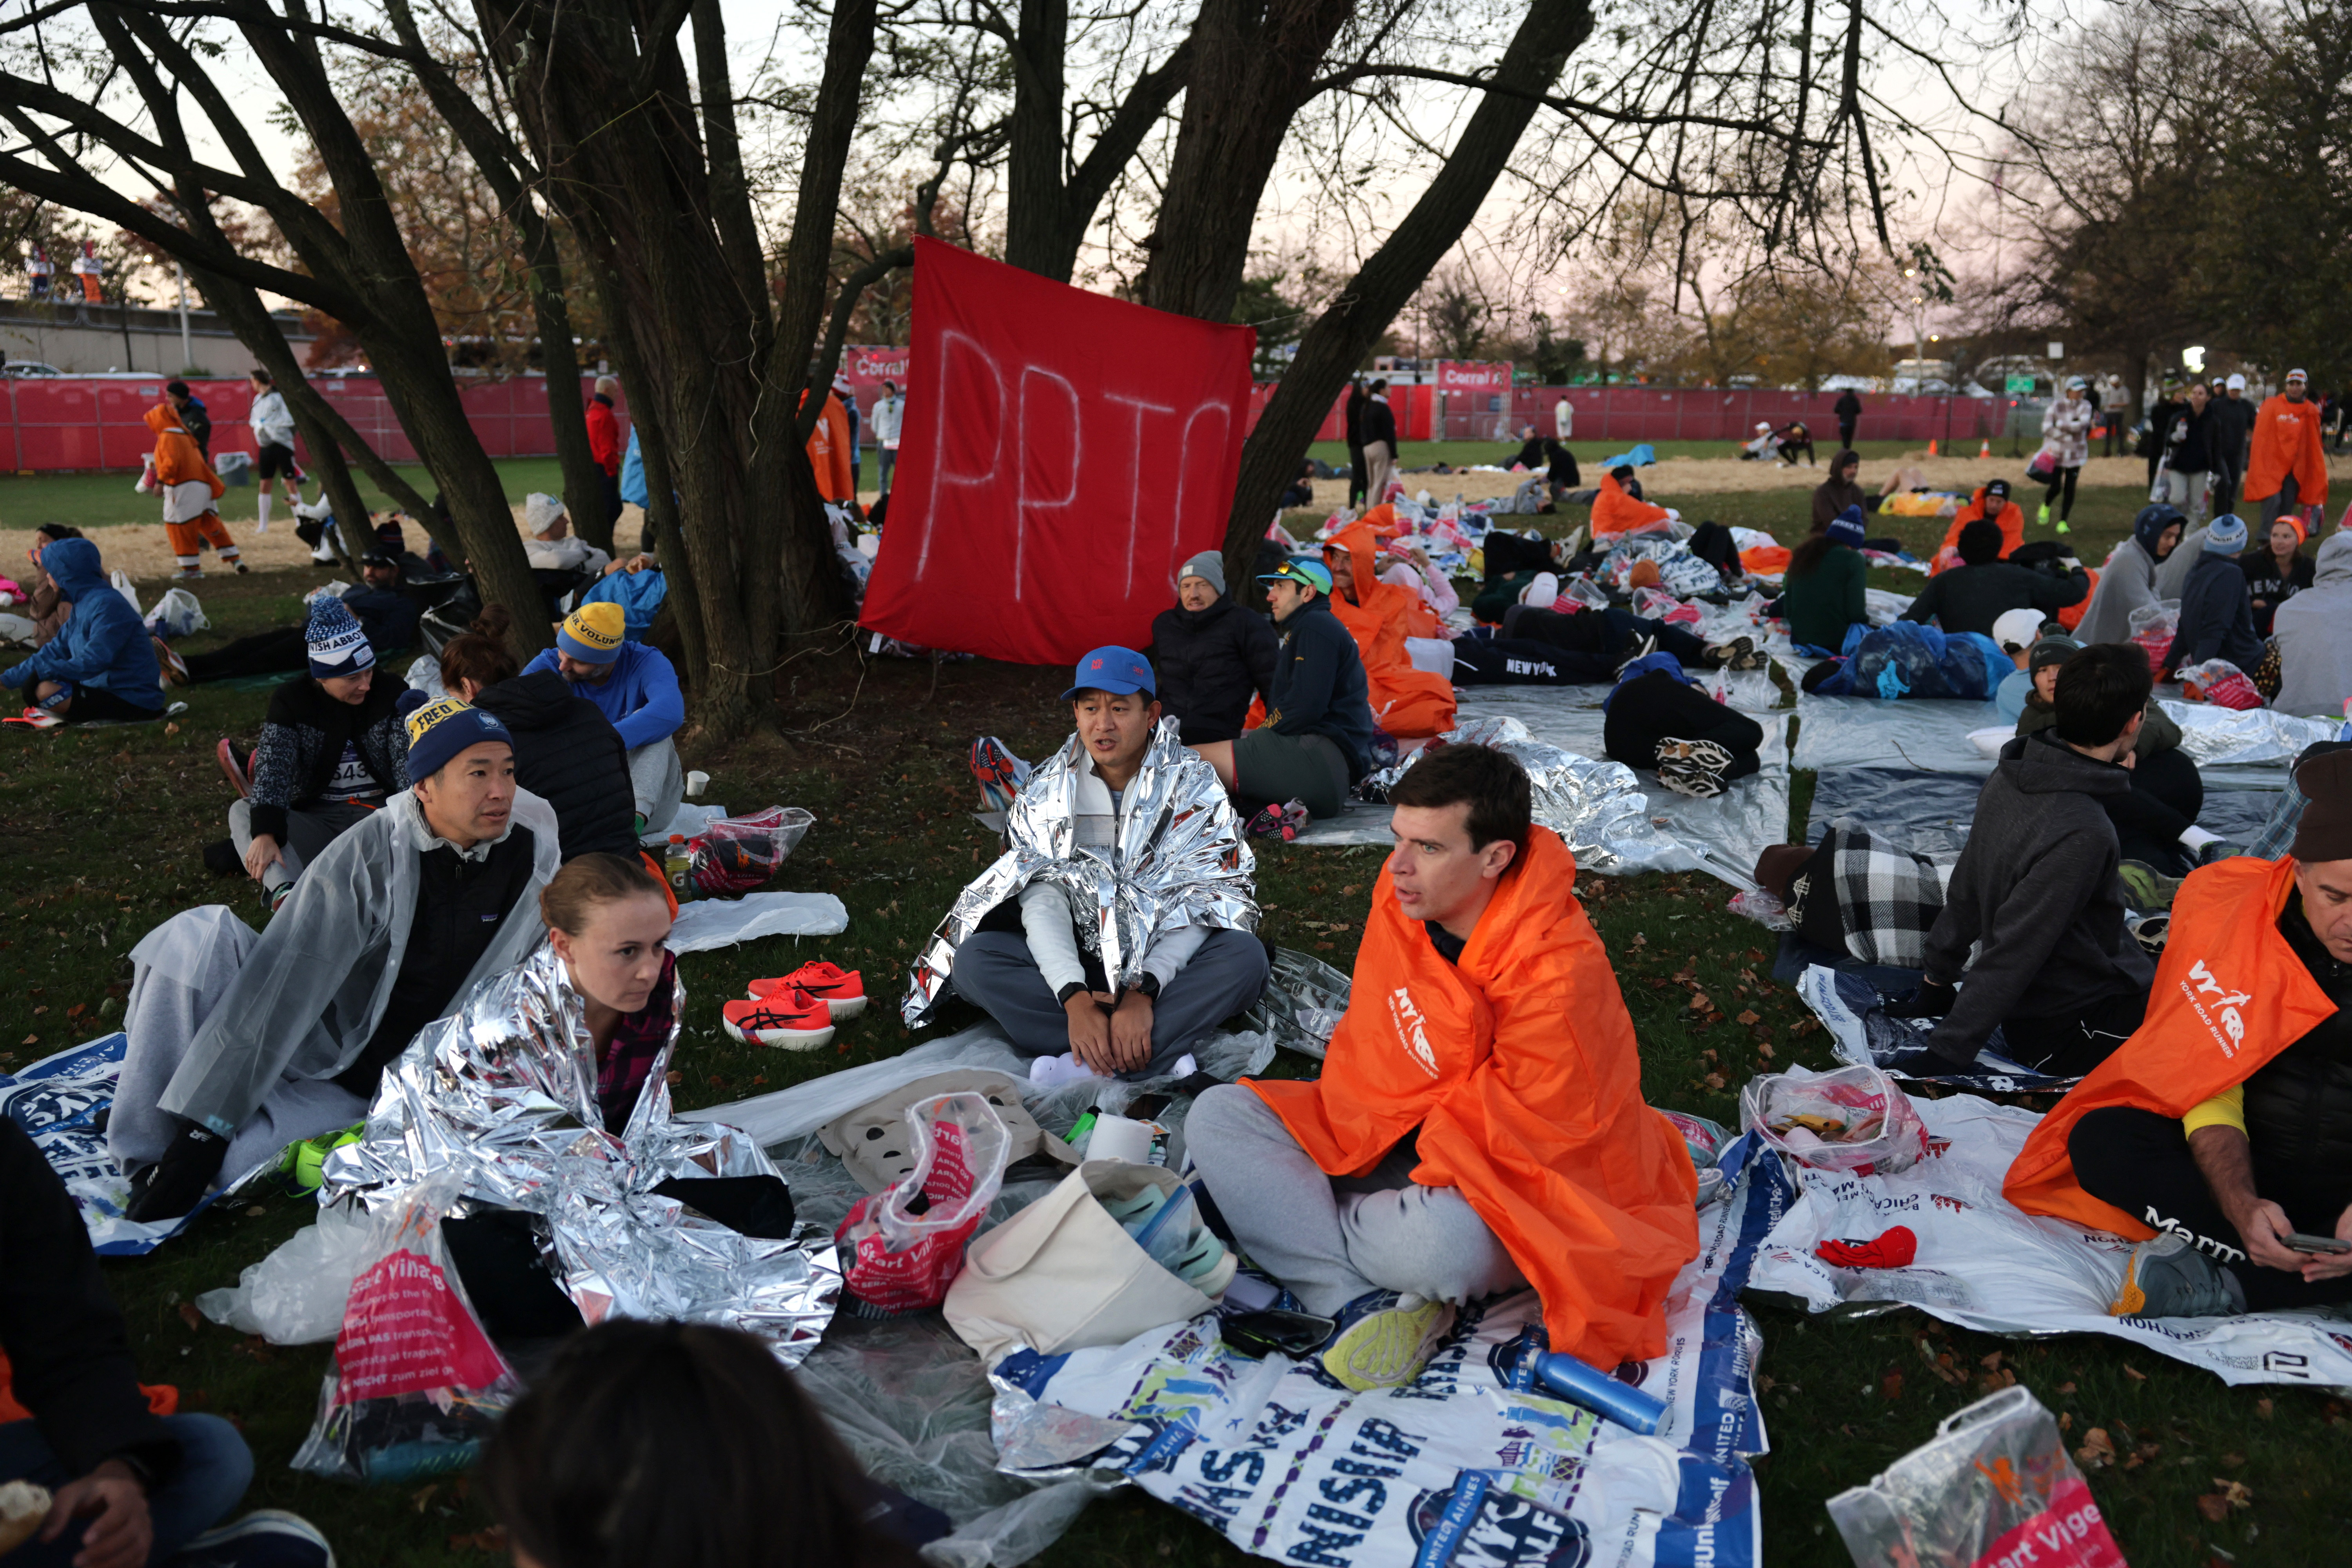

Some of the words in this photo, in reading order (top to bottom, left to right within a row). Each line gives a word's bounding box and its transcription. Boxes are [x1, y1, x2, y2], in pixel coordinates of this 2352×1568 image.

[856, 358, 904, 376] Corral
[1445, 369, 1490, 385] Corral
[1506, 658, 1532, 675] NEW
[416, 704, 452, 731] FRED
[2180, 980, 2197, 1003] YORK
[2193, 1002, 2212, 1025] ROAD
[2209, 1025, 2234, 1058] RUNNERS
[1393, 1010, 1401, 1031] YORK
[1398, 1029, 1409, 1050] ROAD
[1407, 1049, 1439, 1080] RUNNERS
[860, 1242, 904, 1269] Start
[403, 1289, 419, 1298] the
[392, 1371, 416, 1382] zum
[1668, 1368, 1680, 1388] YORK
